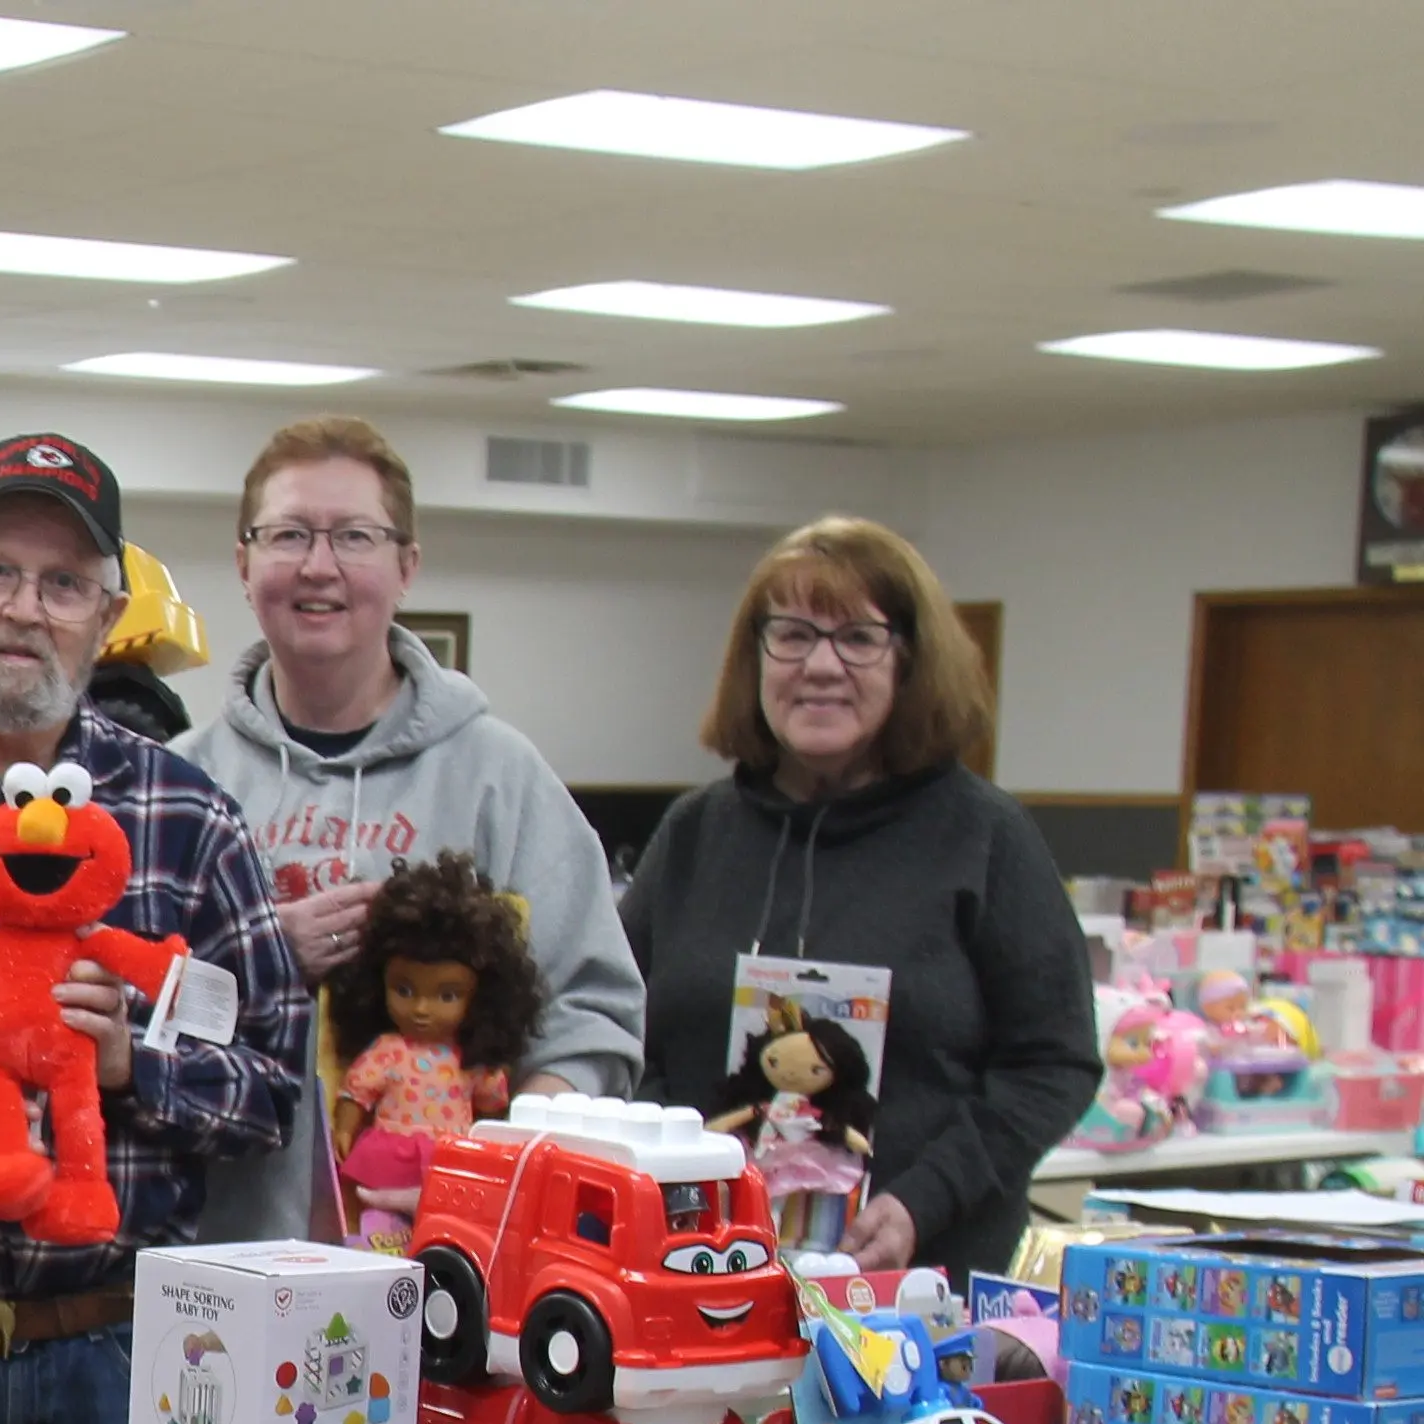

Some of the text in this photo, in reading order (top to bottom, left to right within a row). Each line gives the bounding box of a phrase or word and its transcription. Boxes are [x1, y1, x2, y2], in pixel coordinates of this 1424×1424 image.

[161, 1284, 235, 1311] SHAPE SORTING
[175, 1301, 219, 1322] BABY TOY
